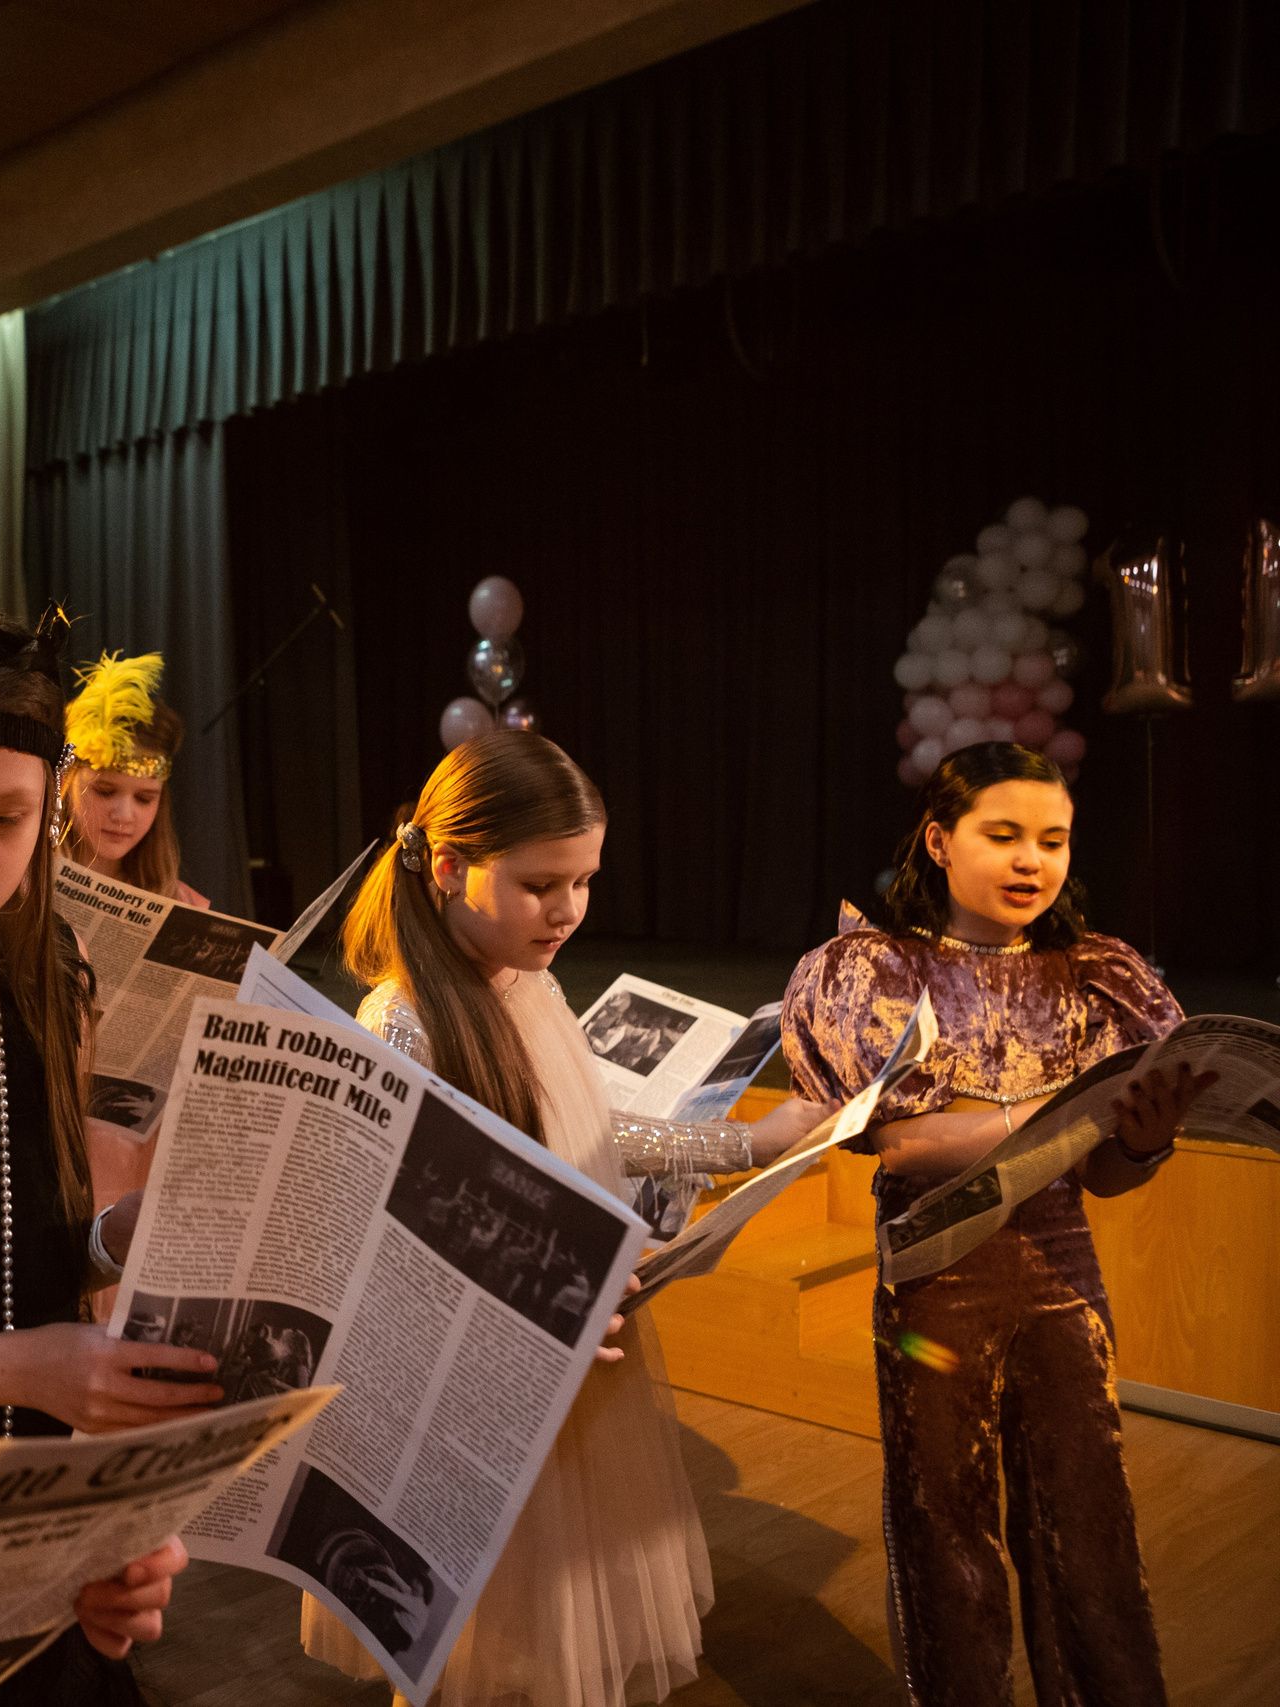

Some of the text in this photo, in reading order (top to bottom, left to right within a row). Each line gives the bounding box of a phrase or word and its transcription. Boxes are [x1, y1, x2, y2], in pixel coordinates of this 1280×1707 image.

[55, 880, 124, 918] Magnificent
[125, 910, 151, 927] Mile
[60, 865, 164, 914] Bank robbery on
[193, 1049, 341, 1102] Magnificent
[343, 1084, 392, 1130] Mile
[203, 1014, 410, 1104] Bank robbery on
